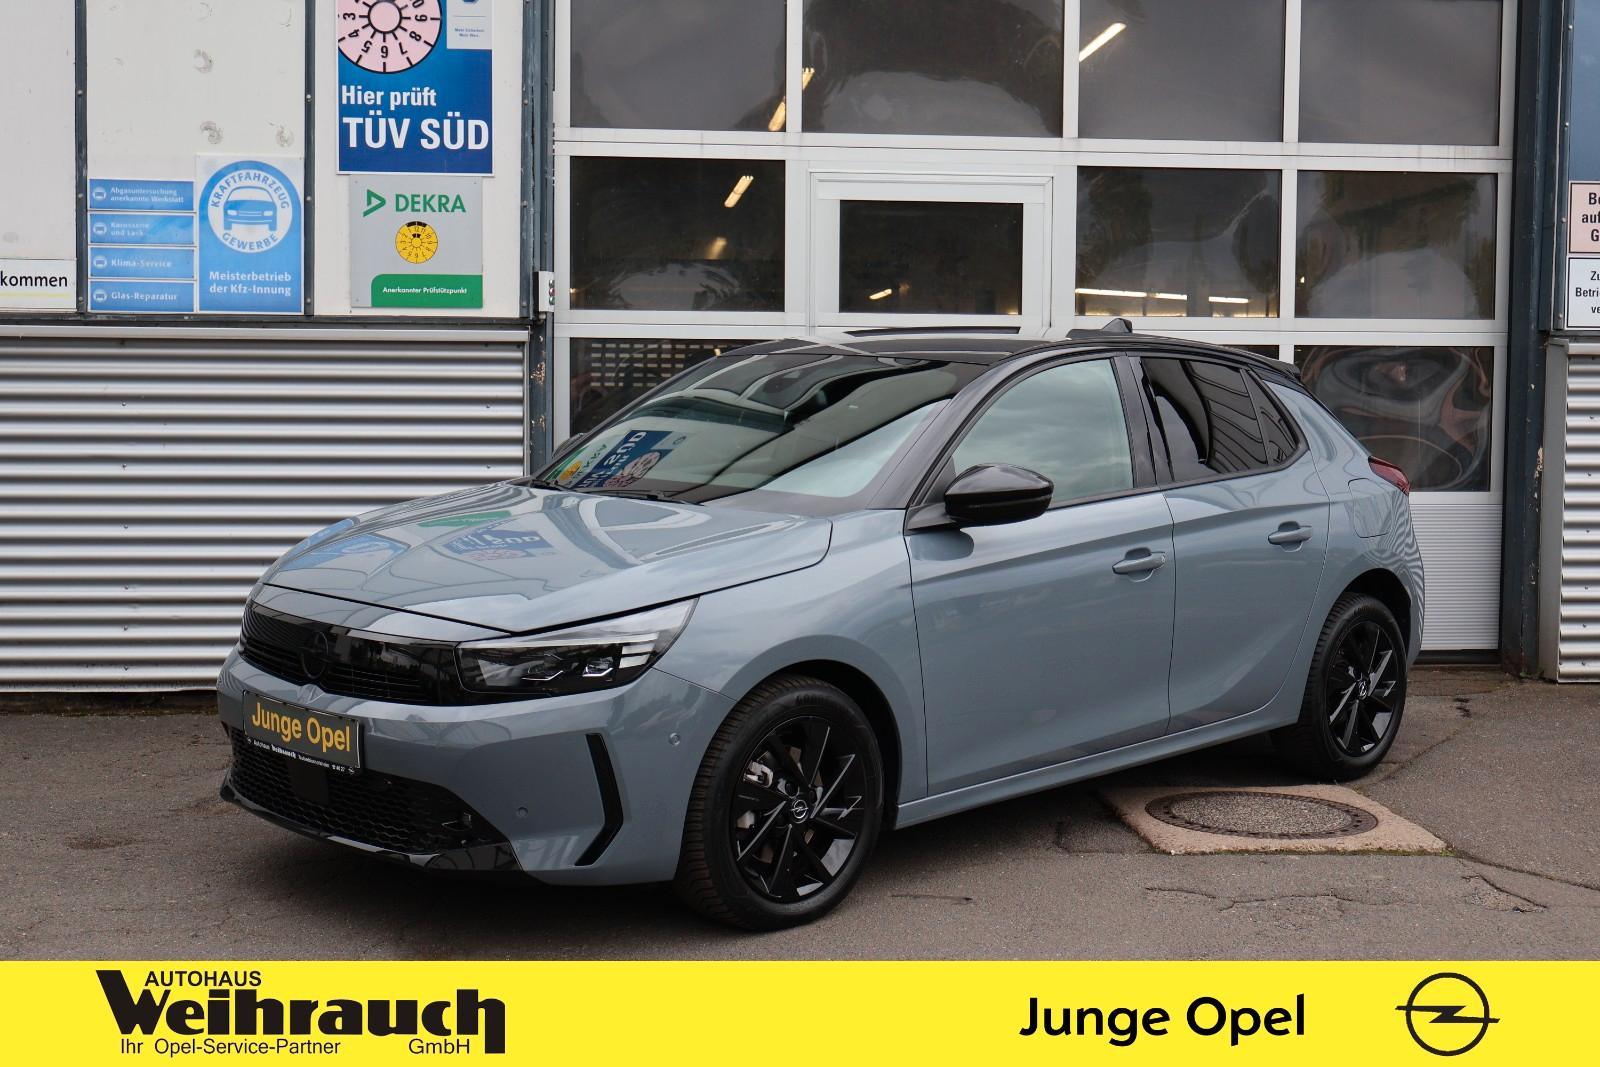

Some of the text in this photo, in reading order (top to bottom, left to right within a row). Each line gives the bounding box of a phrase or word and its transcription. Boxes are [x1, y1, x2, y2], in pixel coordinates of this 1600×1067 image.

[341, 85, 437, 111] Hier prüft
[342, 109, 489, 150] TÜV SÜD
[210, 171, 290, 209] KRAFTFAHRZEUG
[395, 193, 466, 213] DEKRA
[222, 232, 279, 251] GEWERBE
[111, 259, 172, 268] Klima-Service
[0, 270, 68, 287] kommen
[209, 271, 292, 282] Meisterbetrieb
[111, 291, 177, 302] Glas-Reparatur
[209, 284, 292, 297] der Kfz-Innung
[383, 286, 467, 295] Anerkannter Prüfstützpunkt
[1575, 287, 1600, 297] Betri
[252, 702, 350, 753] Junge Opel
